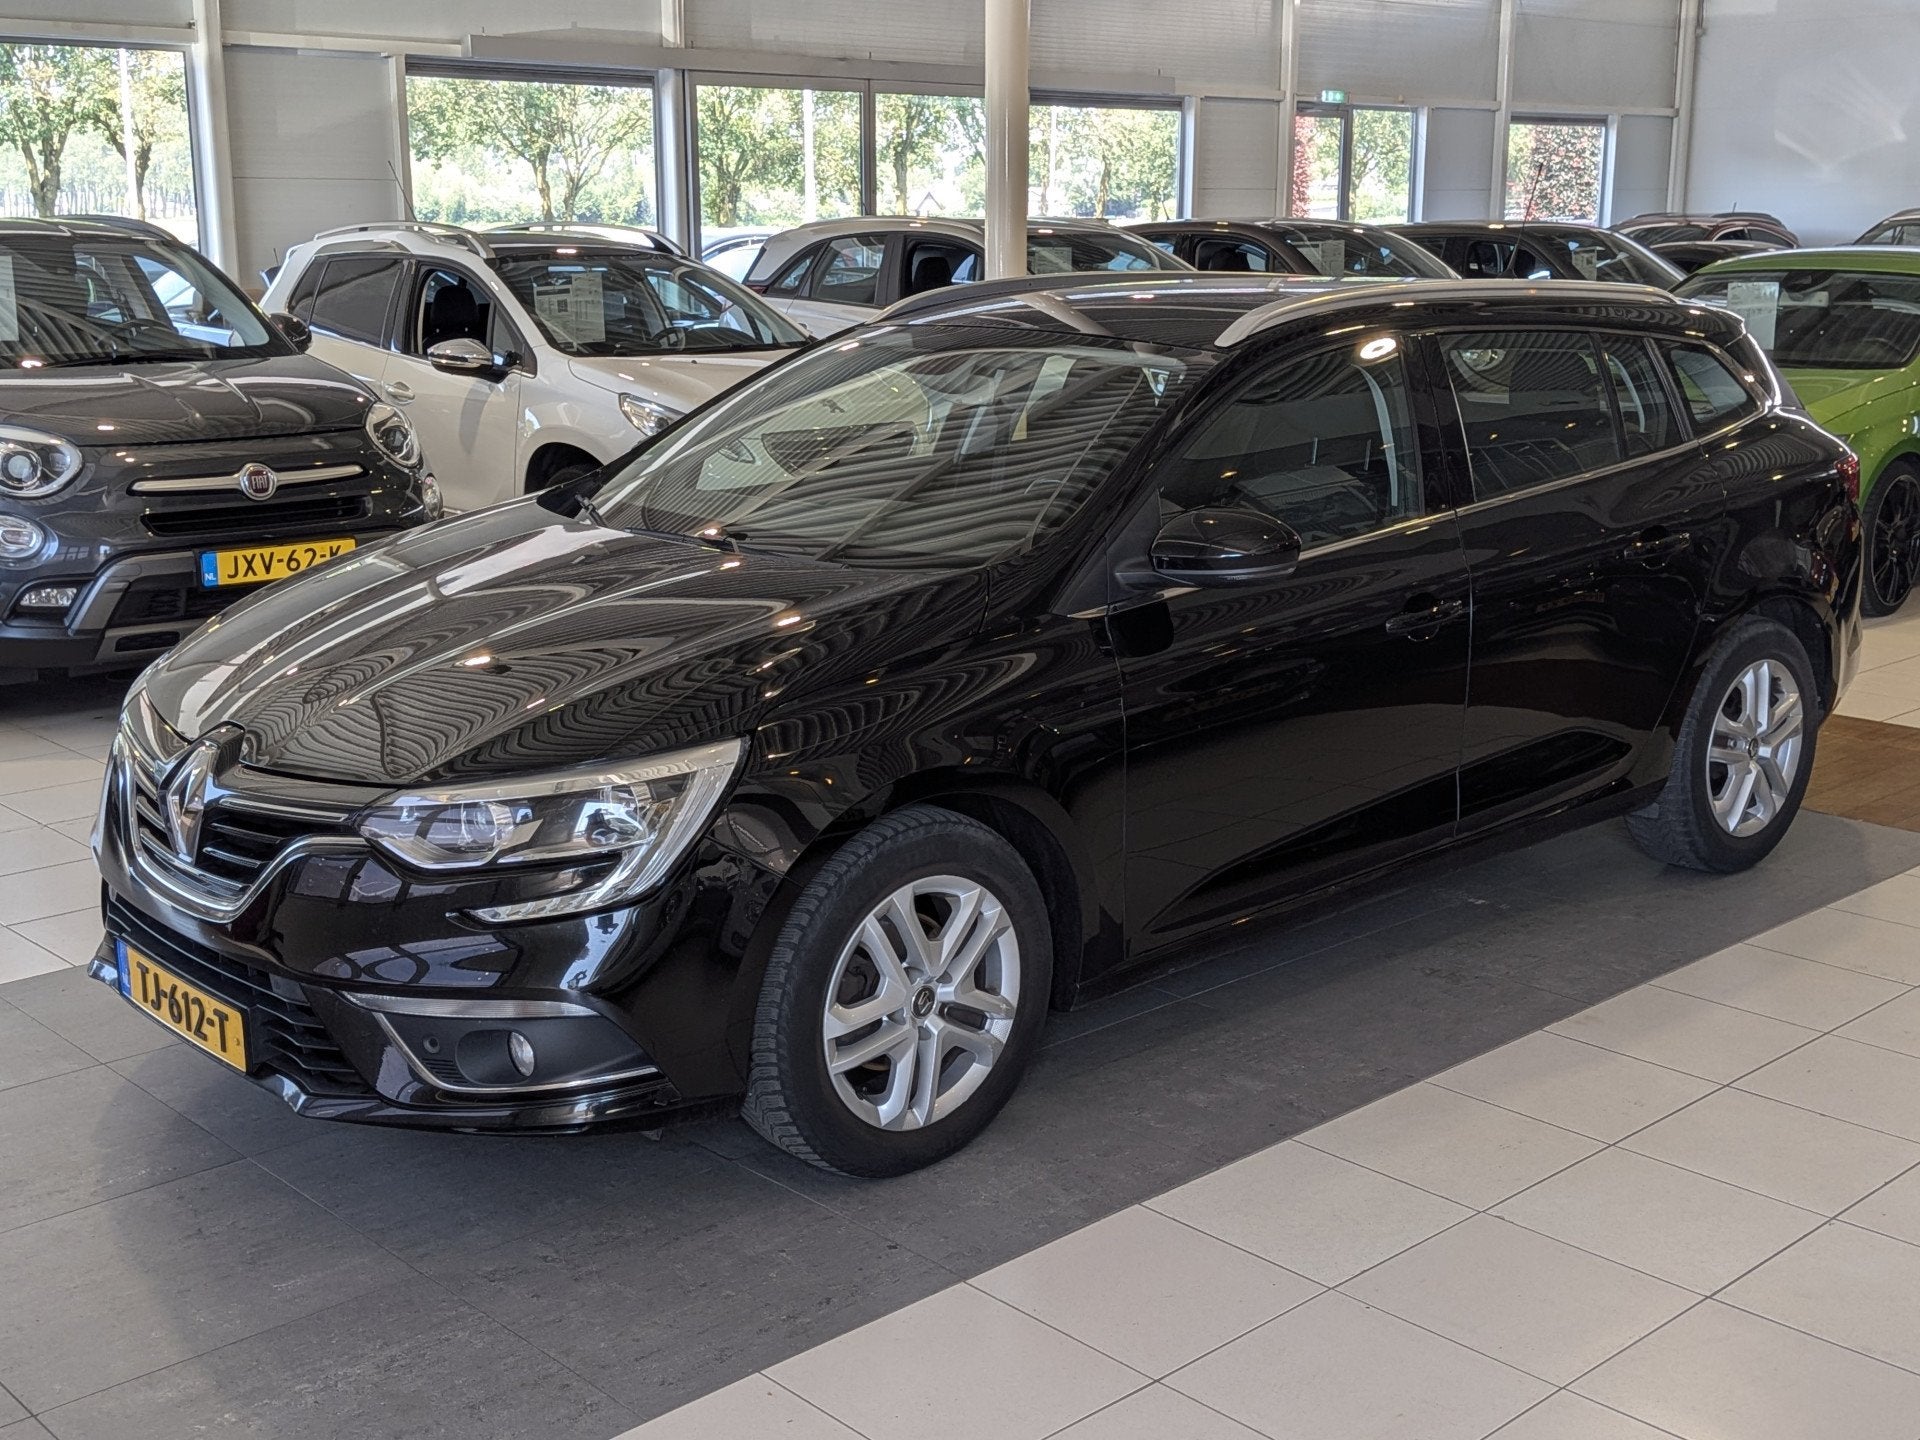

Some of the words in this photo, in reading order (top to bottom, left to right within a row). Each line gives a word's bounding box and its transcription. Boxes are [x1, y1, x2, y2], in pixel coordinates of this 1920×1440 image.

[251, 475, 268, 490] FIAT
[204, 572, 217, 581] NL
[136, 960, 229, 1053] TJ-612-T
